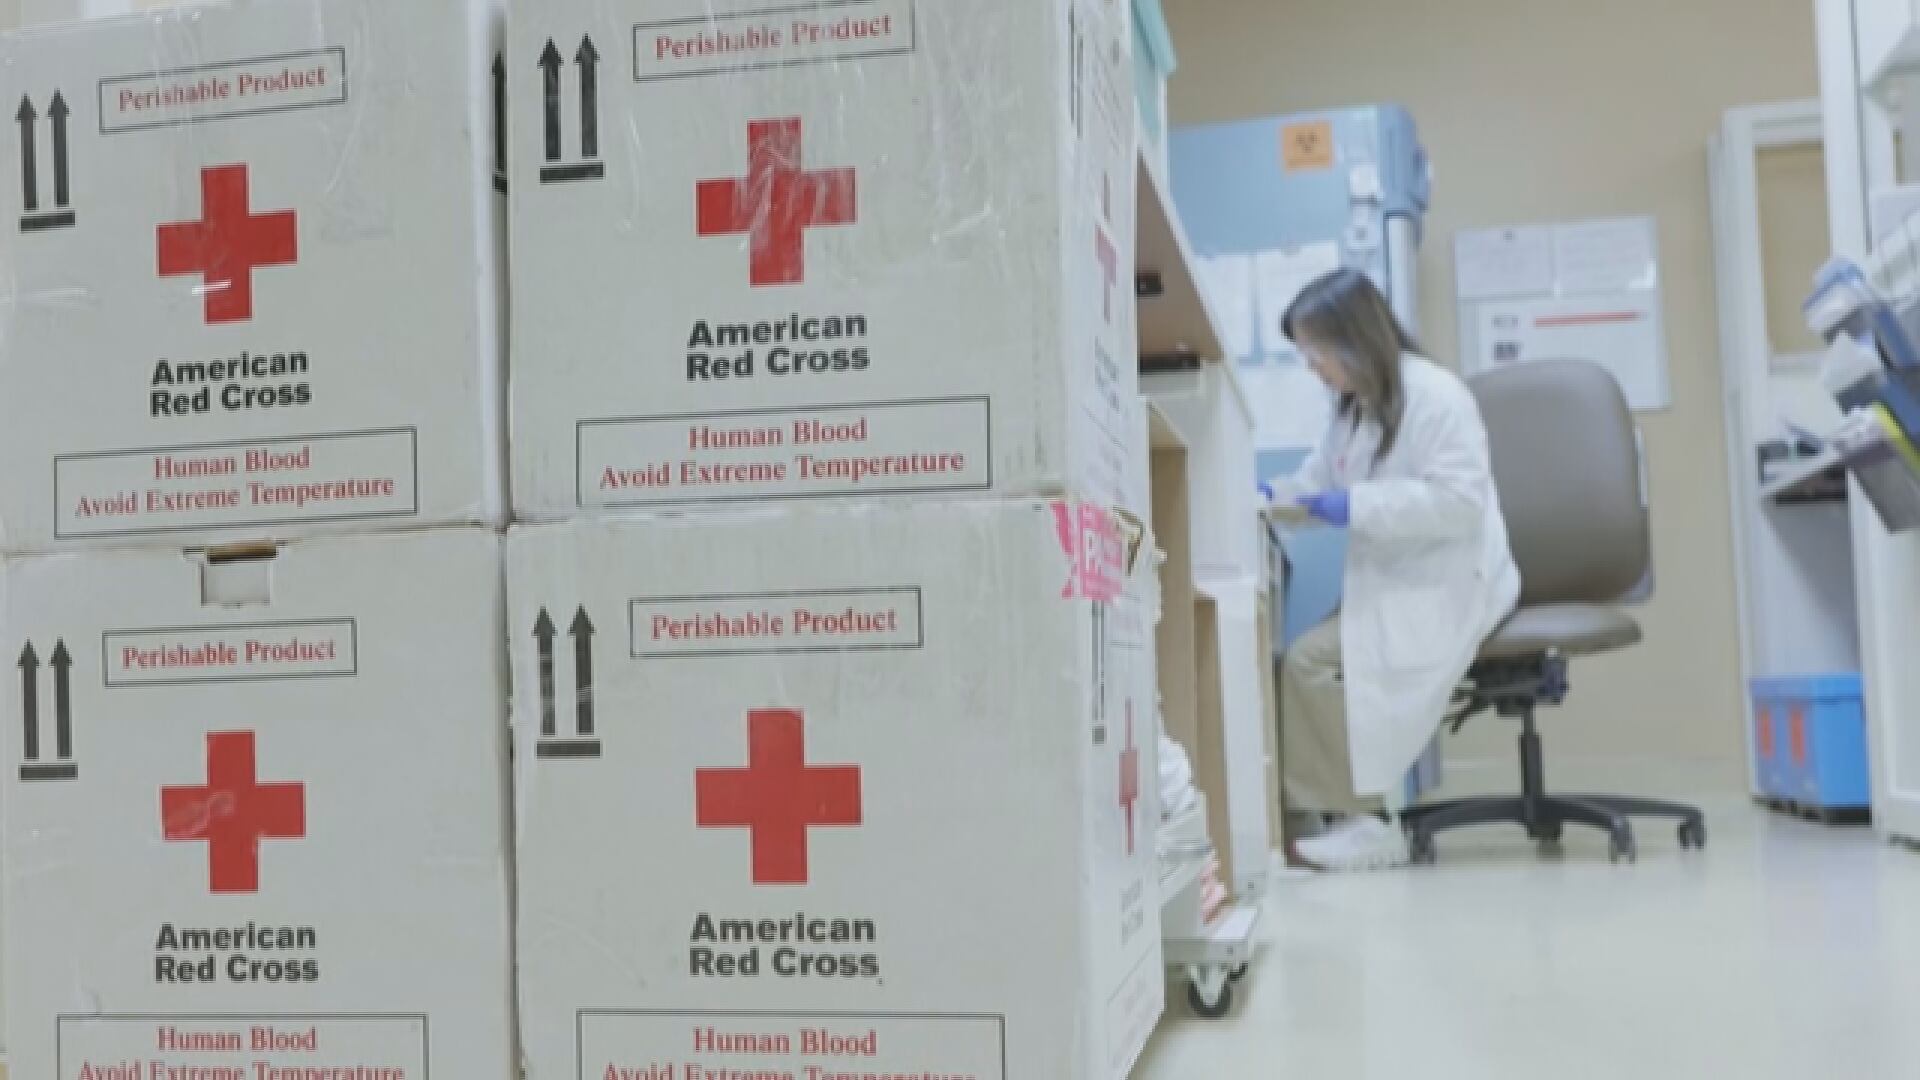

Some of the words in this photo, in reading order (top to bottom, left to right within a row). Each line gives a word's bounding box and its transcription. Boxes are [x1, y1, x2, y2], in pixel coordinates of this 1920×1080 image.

[656, 28, 781, 60] Perishable
[792, 14, 892, 43] Product
[119, 76, 229, 110] Perishable
[239, 65, 325, 96] Product
[687, 313, 867, 348] American
[151, 351, 309, 385] American
[686, 350, 753, 381] Red
[766, 345, 870, 376] Cross
[150, 389, 209, 416] Red
[222, 381, 311, 410] Cross
[689, 425, 782, 450] Human
[793, 417, 867, 444] Blood
[154, 455, 236, 480] Human
[245, 446, 311, 473] Blood
[600, 463, 669, 490] Avoid
[680, 459, 785, 485] Extreme
[796, 450, 965, 482] Temperature
[76, 490, 138, 518] Avoid
[146, 487, 238, 512] Extreme
[247, 478, 394, 508] Temperature
[652, 611, 783, 641] Perishable
[794, 607, 897, 635] Product
[123, 643, 237, 669] Perishable
[246, 639, 336, 663] Product
[155, 921, 316, 950] American
[690, 912, 875, 941] American
[155, 955, 215, 982] Red
[227, 955, 319, 982] Cross
[690, 947, 758, 977] Red
[772, 946, 879, 977] Cross
[158, 1026, 241, 1050] Human
[250, 1026, 317, 1050] Blood
[693, 1026, 790, 1053] Human
[801, 1029, 877, 1056] Blood
[80, 1059, 141, 1080] Avoid
[150, 1061, 245, 1080] Extreme
[252, 1061, 405, 1080] Temperature
